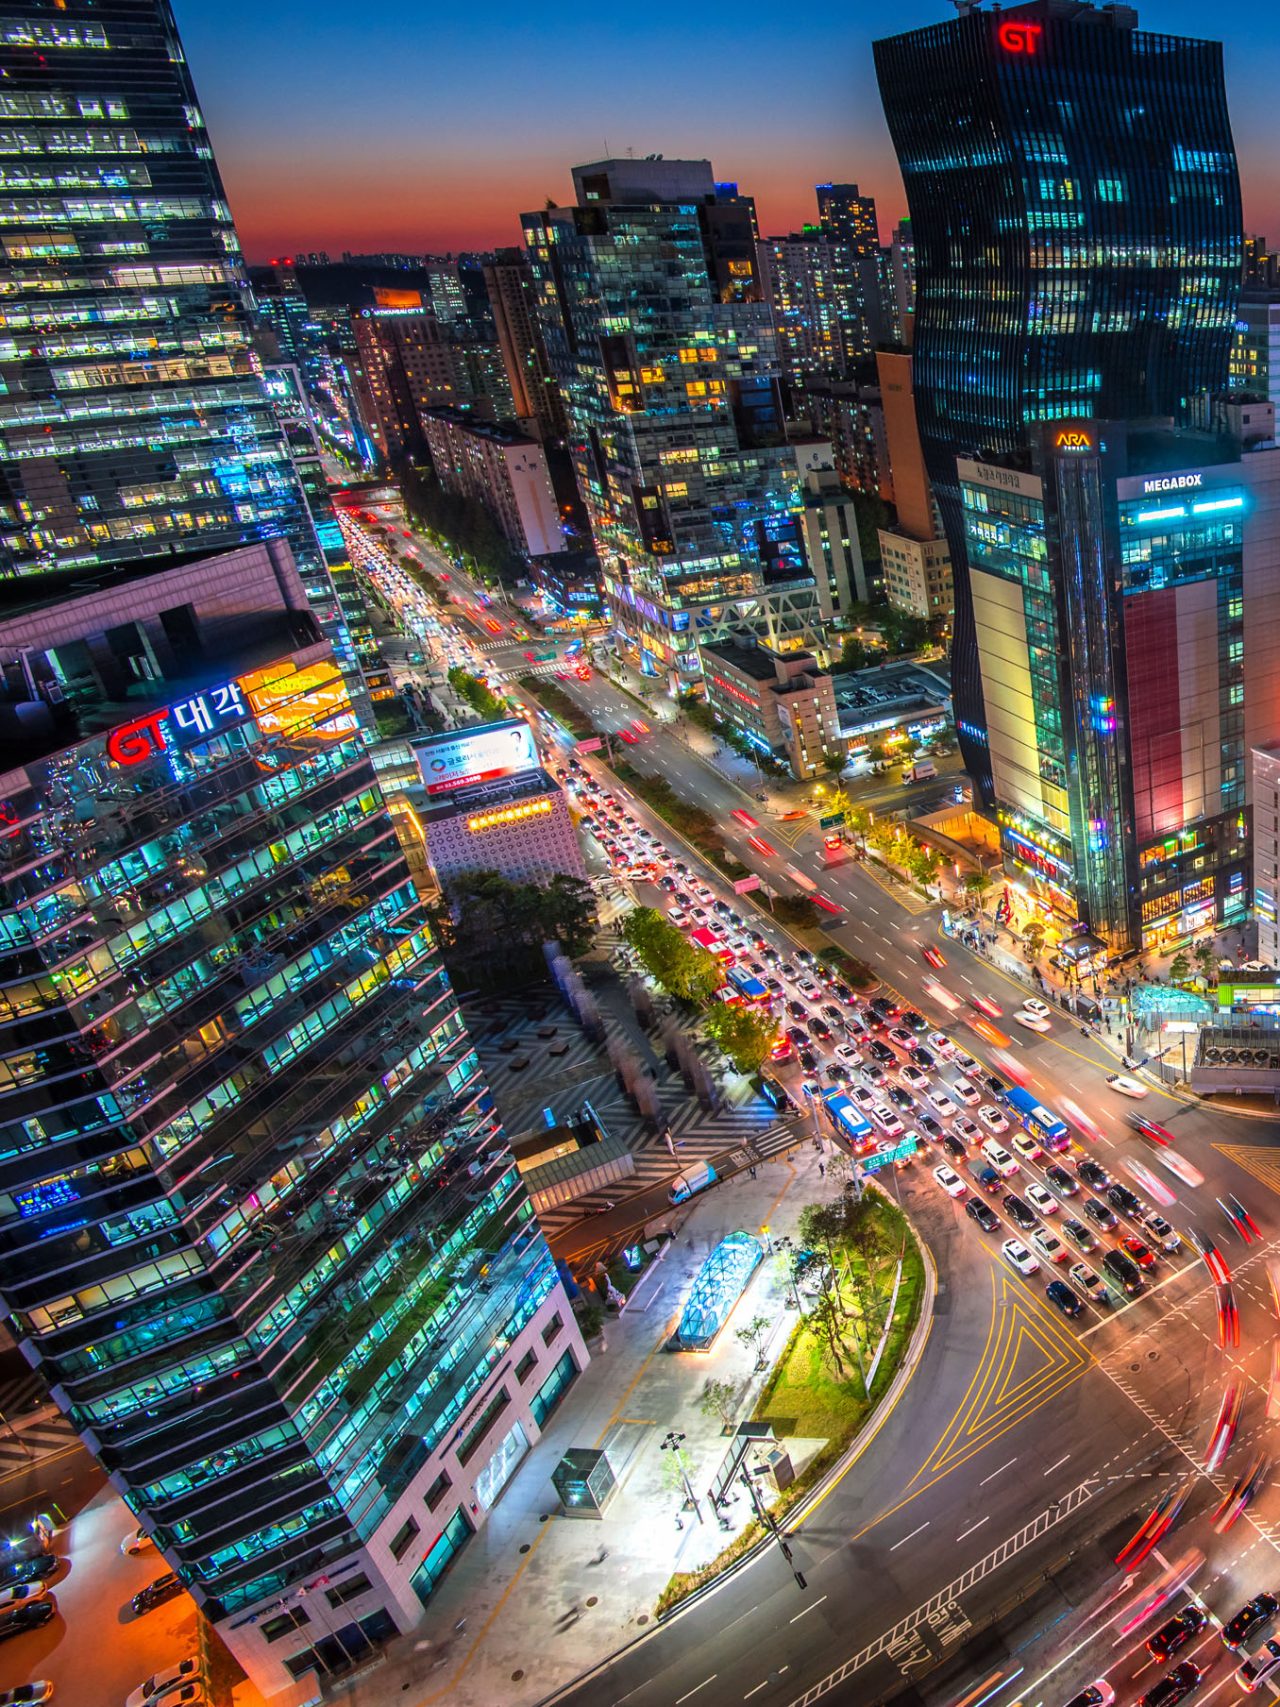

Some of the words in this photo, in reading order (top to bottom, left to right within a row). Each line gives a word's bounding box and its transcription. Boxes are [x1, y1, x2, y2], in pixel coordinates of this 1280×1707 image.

[999, 22, 1041, 54] GT
[1057, 433, 1090, 446] ARA
[1144, 474, 1202, 493] MEGABOX
[109, 709, 169, 765] GT
[173, 683, 245, 733] 대각
